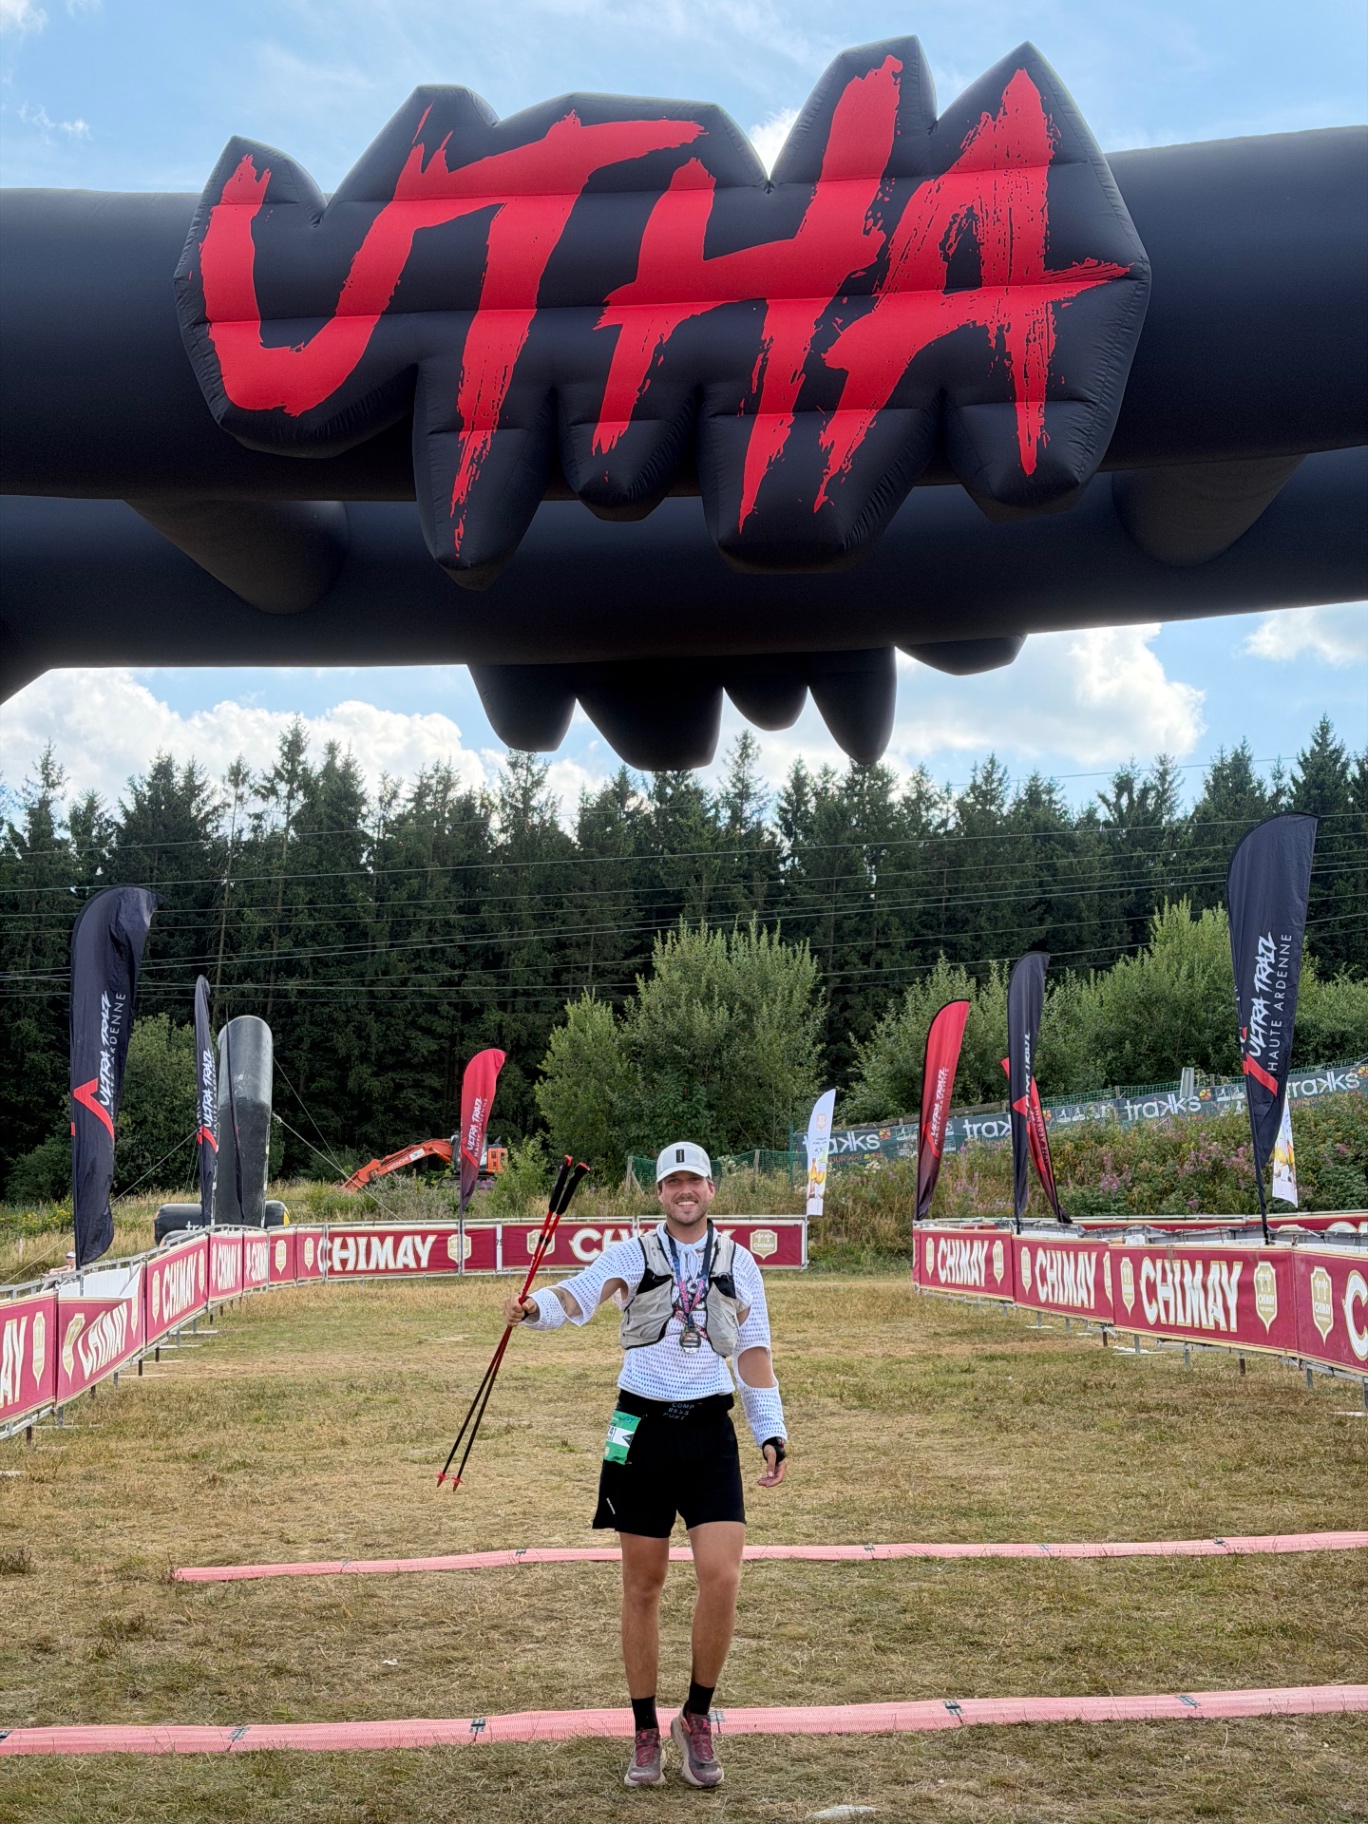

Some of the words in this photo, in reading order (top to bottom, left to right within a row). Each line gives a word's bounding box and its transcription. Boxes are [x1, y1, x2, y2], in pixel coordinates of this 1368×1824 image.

[201, 54, 1133, 558] UTHA
[1254, 931, 1278, 993] TRAIL
[1274, 934, 1292, 1011] ARDENNE
[101, 990, 112, 1047] TRAIL
[1249, 995, 1271, 1057] ULTRA
[1267, 1019, 1283, 1072] HAUTE
[99, 1050, 111, 1106] ULTRA
[204, 1048, 213, 1088] TRAIL
[203, 1088, 213, 1128] ULTRA
[471, 1096, 483, 1123] TRAIL
[1124, 1093, 1202, 1121] trakks
[467, 1124, 478, 1151] ULTRA
[317, 1234, 437, 1273] CHIMAY
[937, 1237, 989, 1287] CHIMAY
[1034, 1247, 1097, 1309] CHIMAY
[163, 1252, 197, 1324] CHIMAY
[1139, 1256, 1243, 1333] CHIMAY
[0, 1316, 28, 1408] AY
